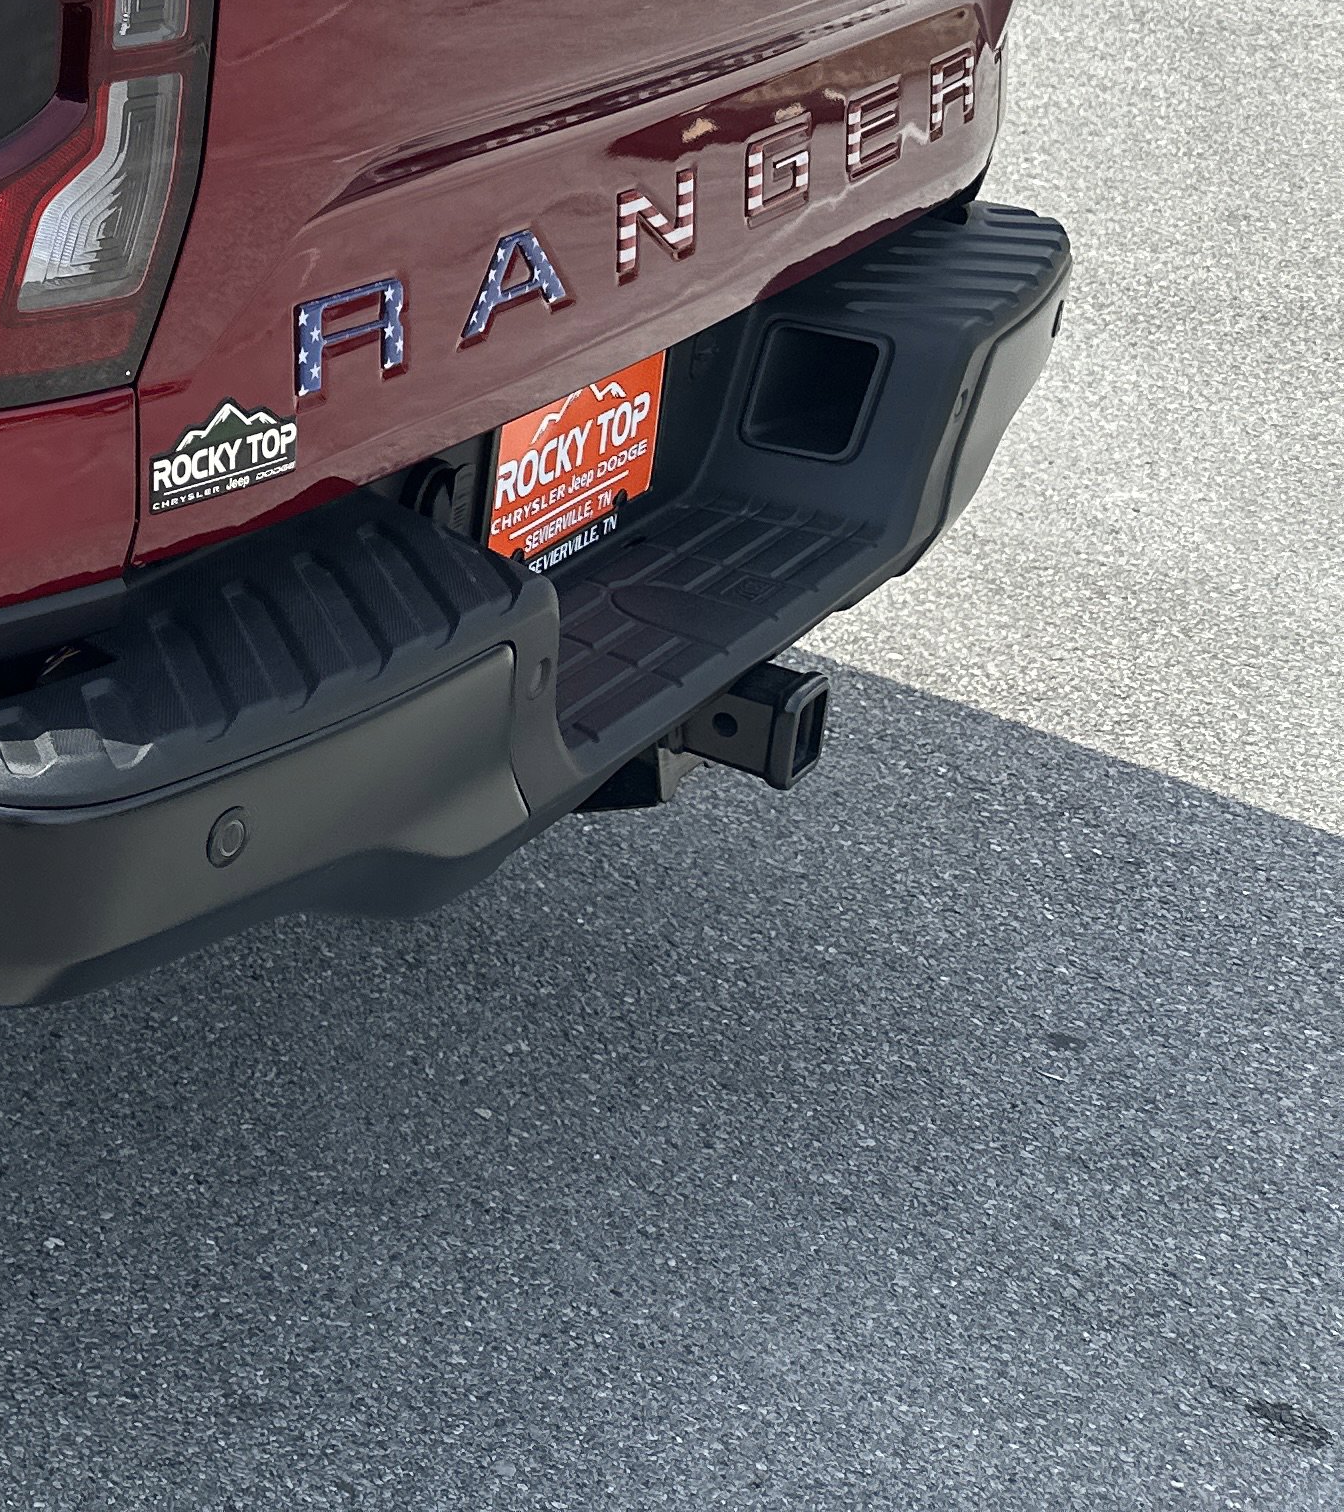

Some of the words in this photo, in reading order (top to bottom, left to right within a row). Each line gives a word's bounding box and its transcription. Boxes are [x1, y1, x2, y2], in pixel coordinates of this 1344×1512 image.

[293, 43, 976, 411] RANGER
[152, 485, 220, 510] CHRYSLER
[226, 474, 250, 491] Jeep
[256, 460, 297, 481] DODGE
[153, 438, 242, 492] ROCKY
[246, 422, 297, 464] TOP
[494, 419, 594, 510] ROCKY
[597, 391, 651, 455] TOP
[491, 483, 566, 535] CHRYSLER
[568, 469, 594, 494] Jeep
[596, 438, 648, 478] DODGE
[524, 500, 594, 553] SEVIERVILLE,
[597, 489, 613, 511] TN
[528, 524, 600, 574] SEVIERVILLE,
[602, 513, 618, 536] TN
